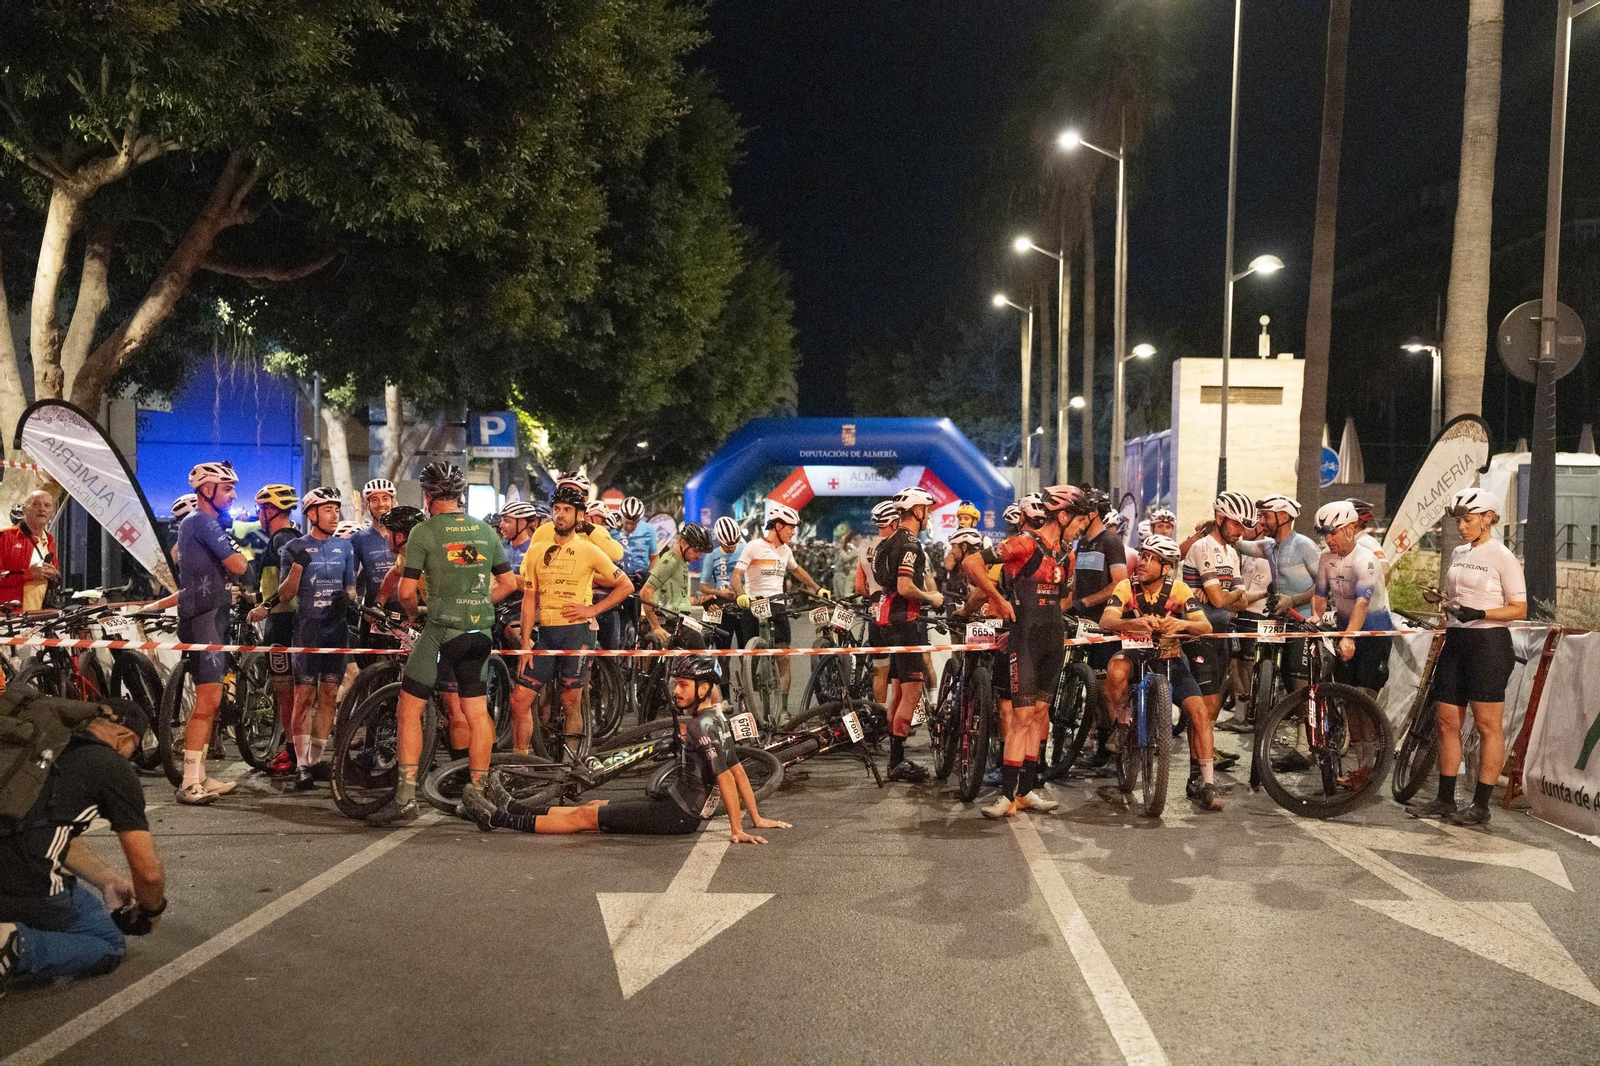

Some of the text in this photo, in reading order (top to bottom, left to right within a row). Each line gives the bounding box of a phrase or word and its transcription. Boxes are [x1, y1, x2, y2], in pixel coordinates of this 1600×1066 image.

[480, 416, 506, 445] P
[799, 449, 898, 458] DIPUTACIÓN DE ALMERÍA
[849, 472, 901, 482] ALMEA
[1416, 453, 1474, 518] ALMERÍA
[106, 619, 128, 628] 6358
[738, 717, 752, 737] 6709
[1541, 775, 1573, 805] Junta
[1575, 785, 1591, 810] de
